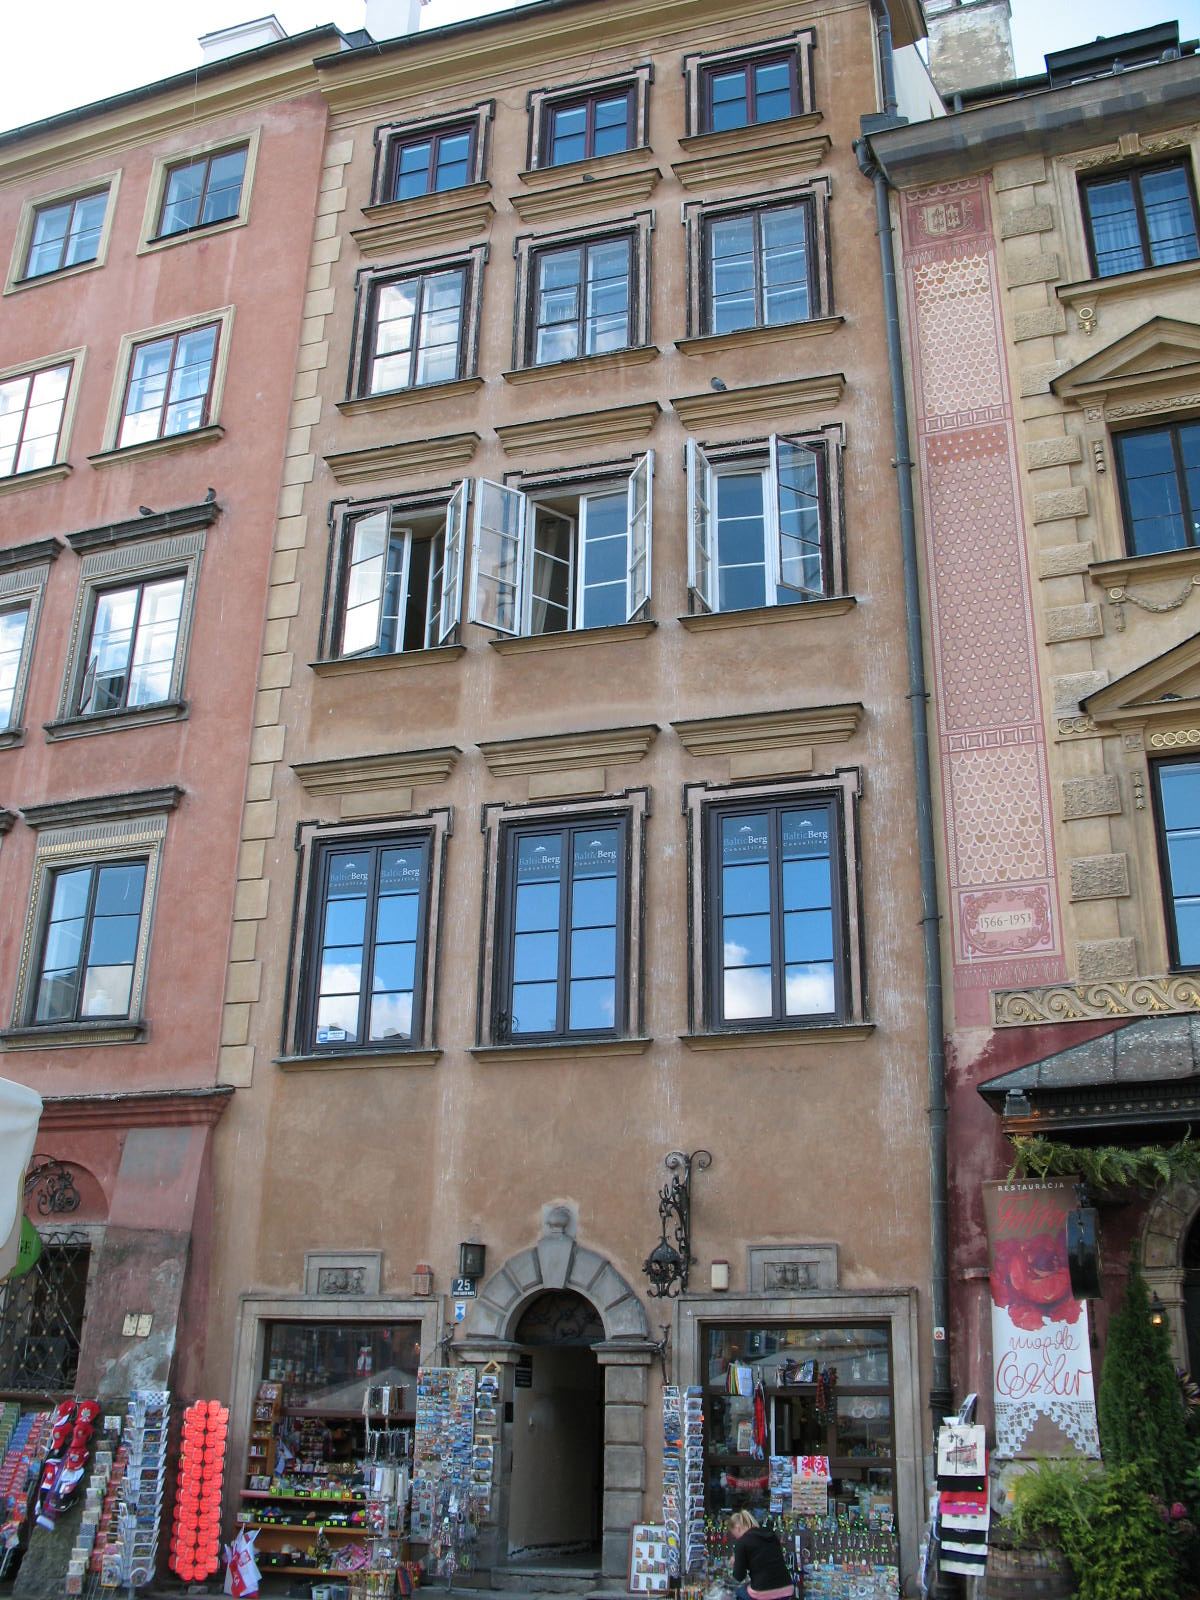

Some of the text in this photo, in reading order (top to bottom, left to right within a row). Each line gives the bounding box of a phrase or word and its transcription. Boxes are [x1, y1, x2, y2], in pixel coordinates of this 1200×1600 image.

[784, 831, 828, 840] BalticBerg
[723, 836, 768, 846] BalticBerg
[575, 850, 617, 860] BalticBerg
[519, 856, 560, 865] BalticBerg
[329, 871, 368, 881] BalticBerg
[381, 868, 420, 877] BalticBerg
[980, 912, 1032, 929] 1566-1953
[997, 1182, 1065, 1192] RESTAURACJA
[457, 1279, 471, 1291] 25
